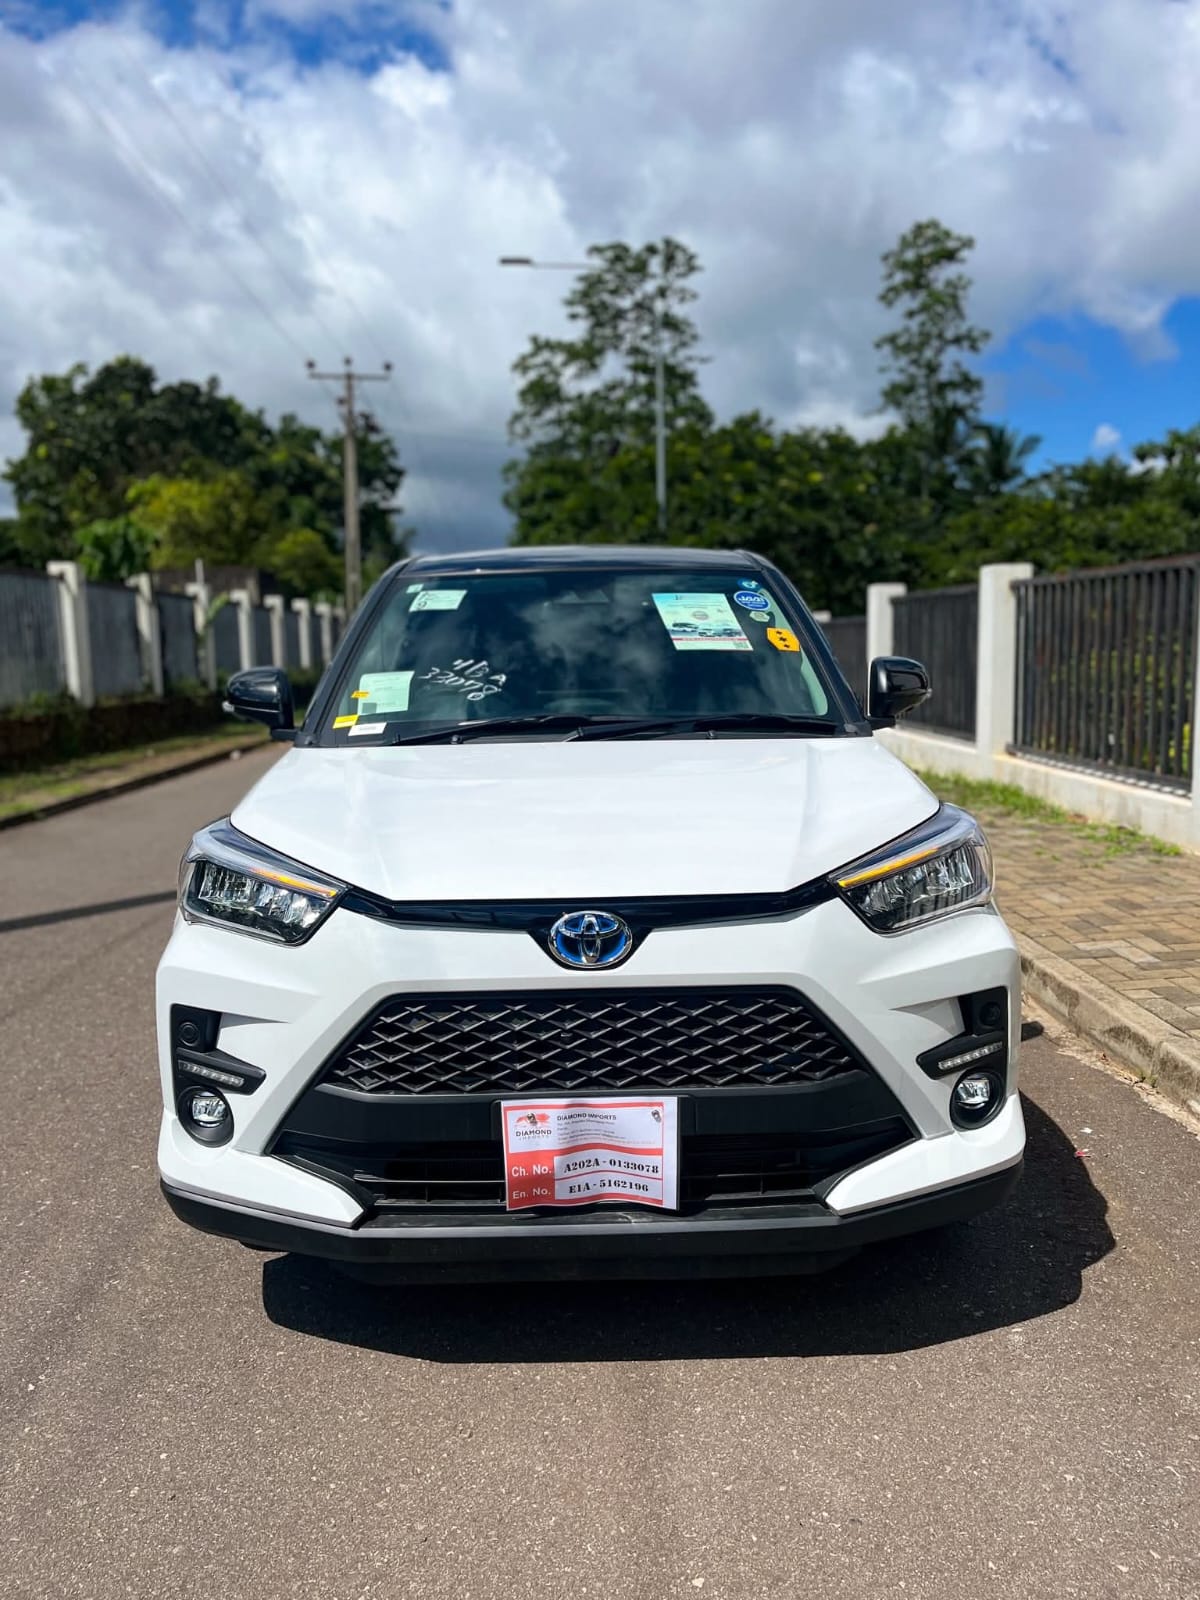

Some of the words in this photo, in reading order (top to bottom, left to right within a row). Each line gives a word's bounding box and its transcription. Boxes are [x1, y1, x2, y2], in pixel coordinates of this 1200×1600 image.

[557, 1113, 587, 1121] DIAMOND
[588, 1113, 617, 1121] IMPORTS
[515, 1129, 552, 1137] DIAMOND
[511, 1166, 529, 1177] Ch.
[532, 1164, 552, 1175] No.
[512, 1190, 529, 1199] En.
[532, 1187, 551, 1196] No.
